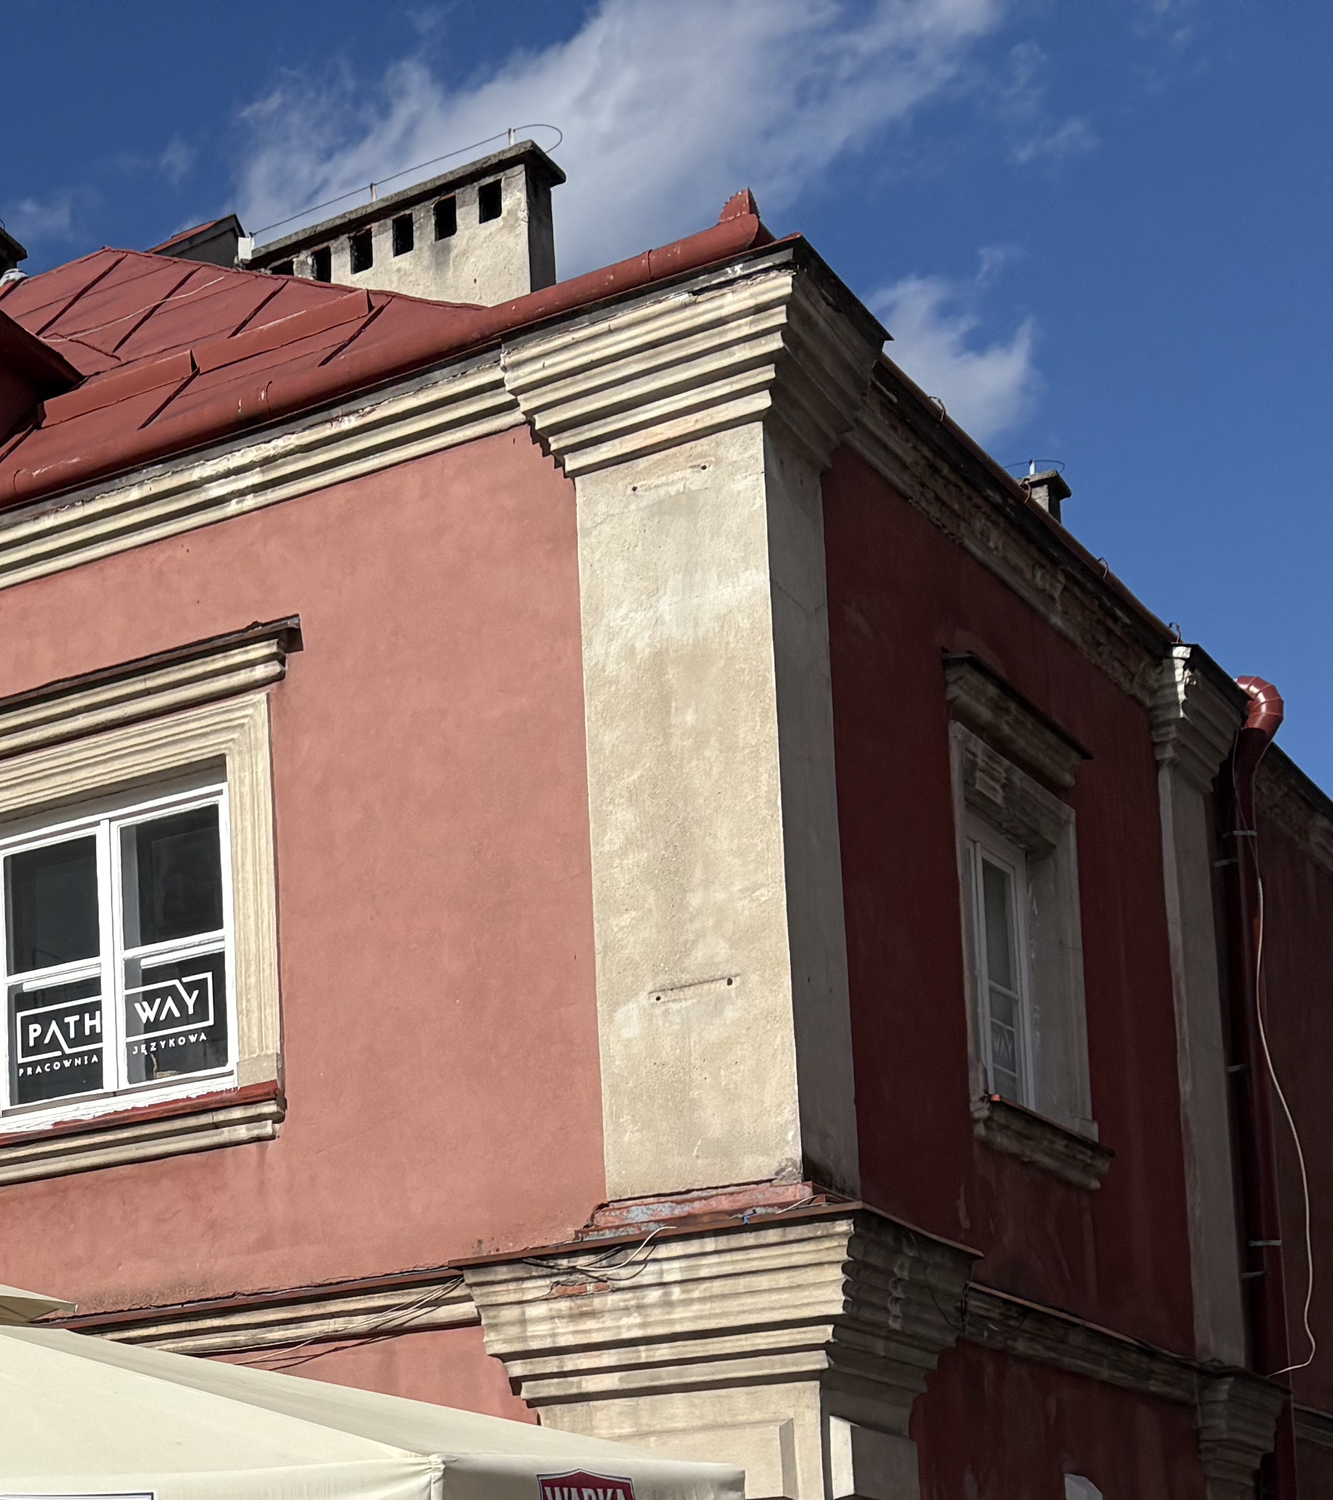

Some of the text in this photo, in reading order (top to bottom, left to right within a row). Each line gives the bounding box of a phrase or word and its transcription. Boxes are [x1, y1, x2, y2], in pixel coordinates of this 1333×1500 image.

[28, 990, 199, 1047] PATH WAY
[19, 1032, 207, 1077] PRACOWNIA JĘZYKOWA
